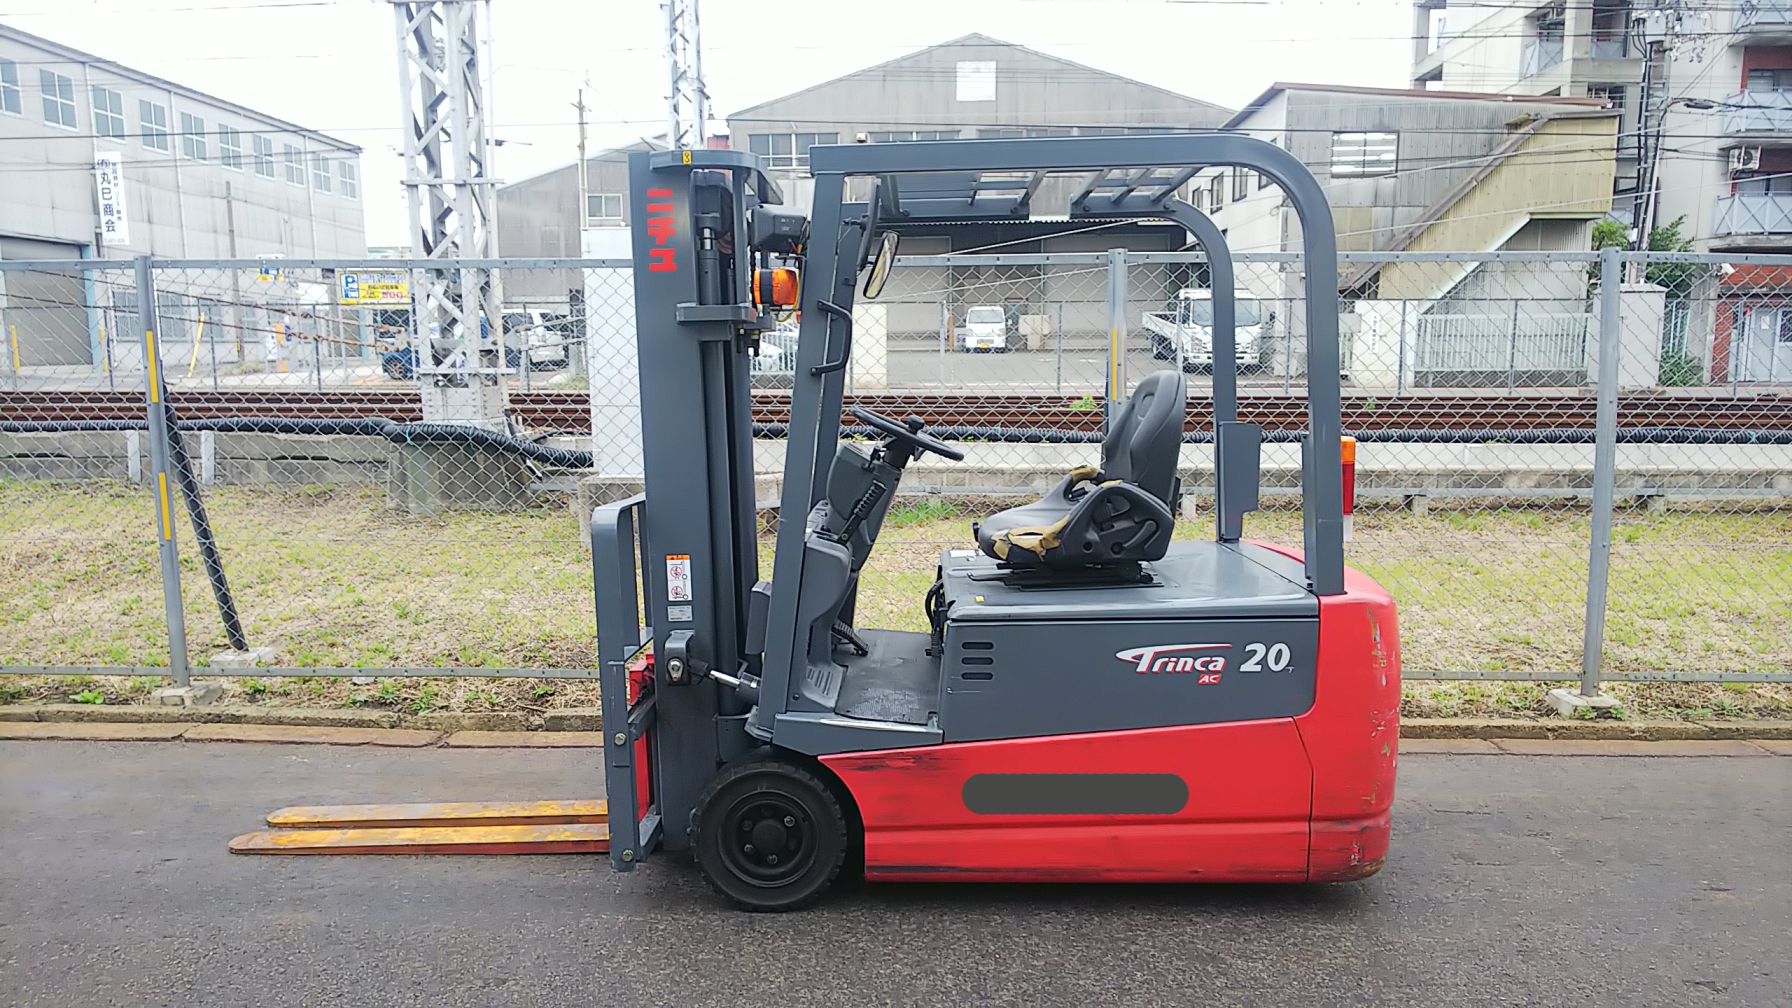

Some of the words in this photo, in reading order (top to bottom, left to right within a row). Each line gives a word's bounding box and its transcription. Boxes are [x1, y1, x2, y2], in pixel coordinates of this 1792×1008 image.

[646, 189, 677, 272] ニチユ
[345, 276, 355, 287] P
[1115, 643, 1232, 674] Trinca
[1198, 674, 1221, 684] AC
